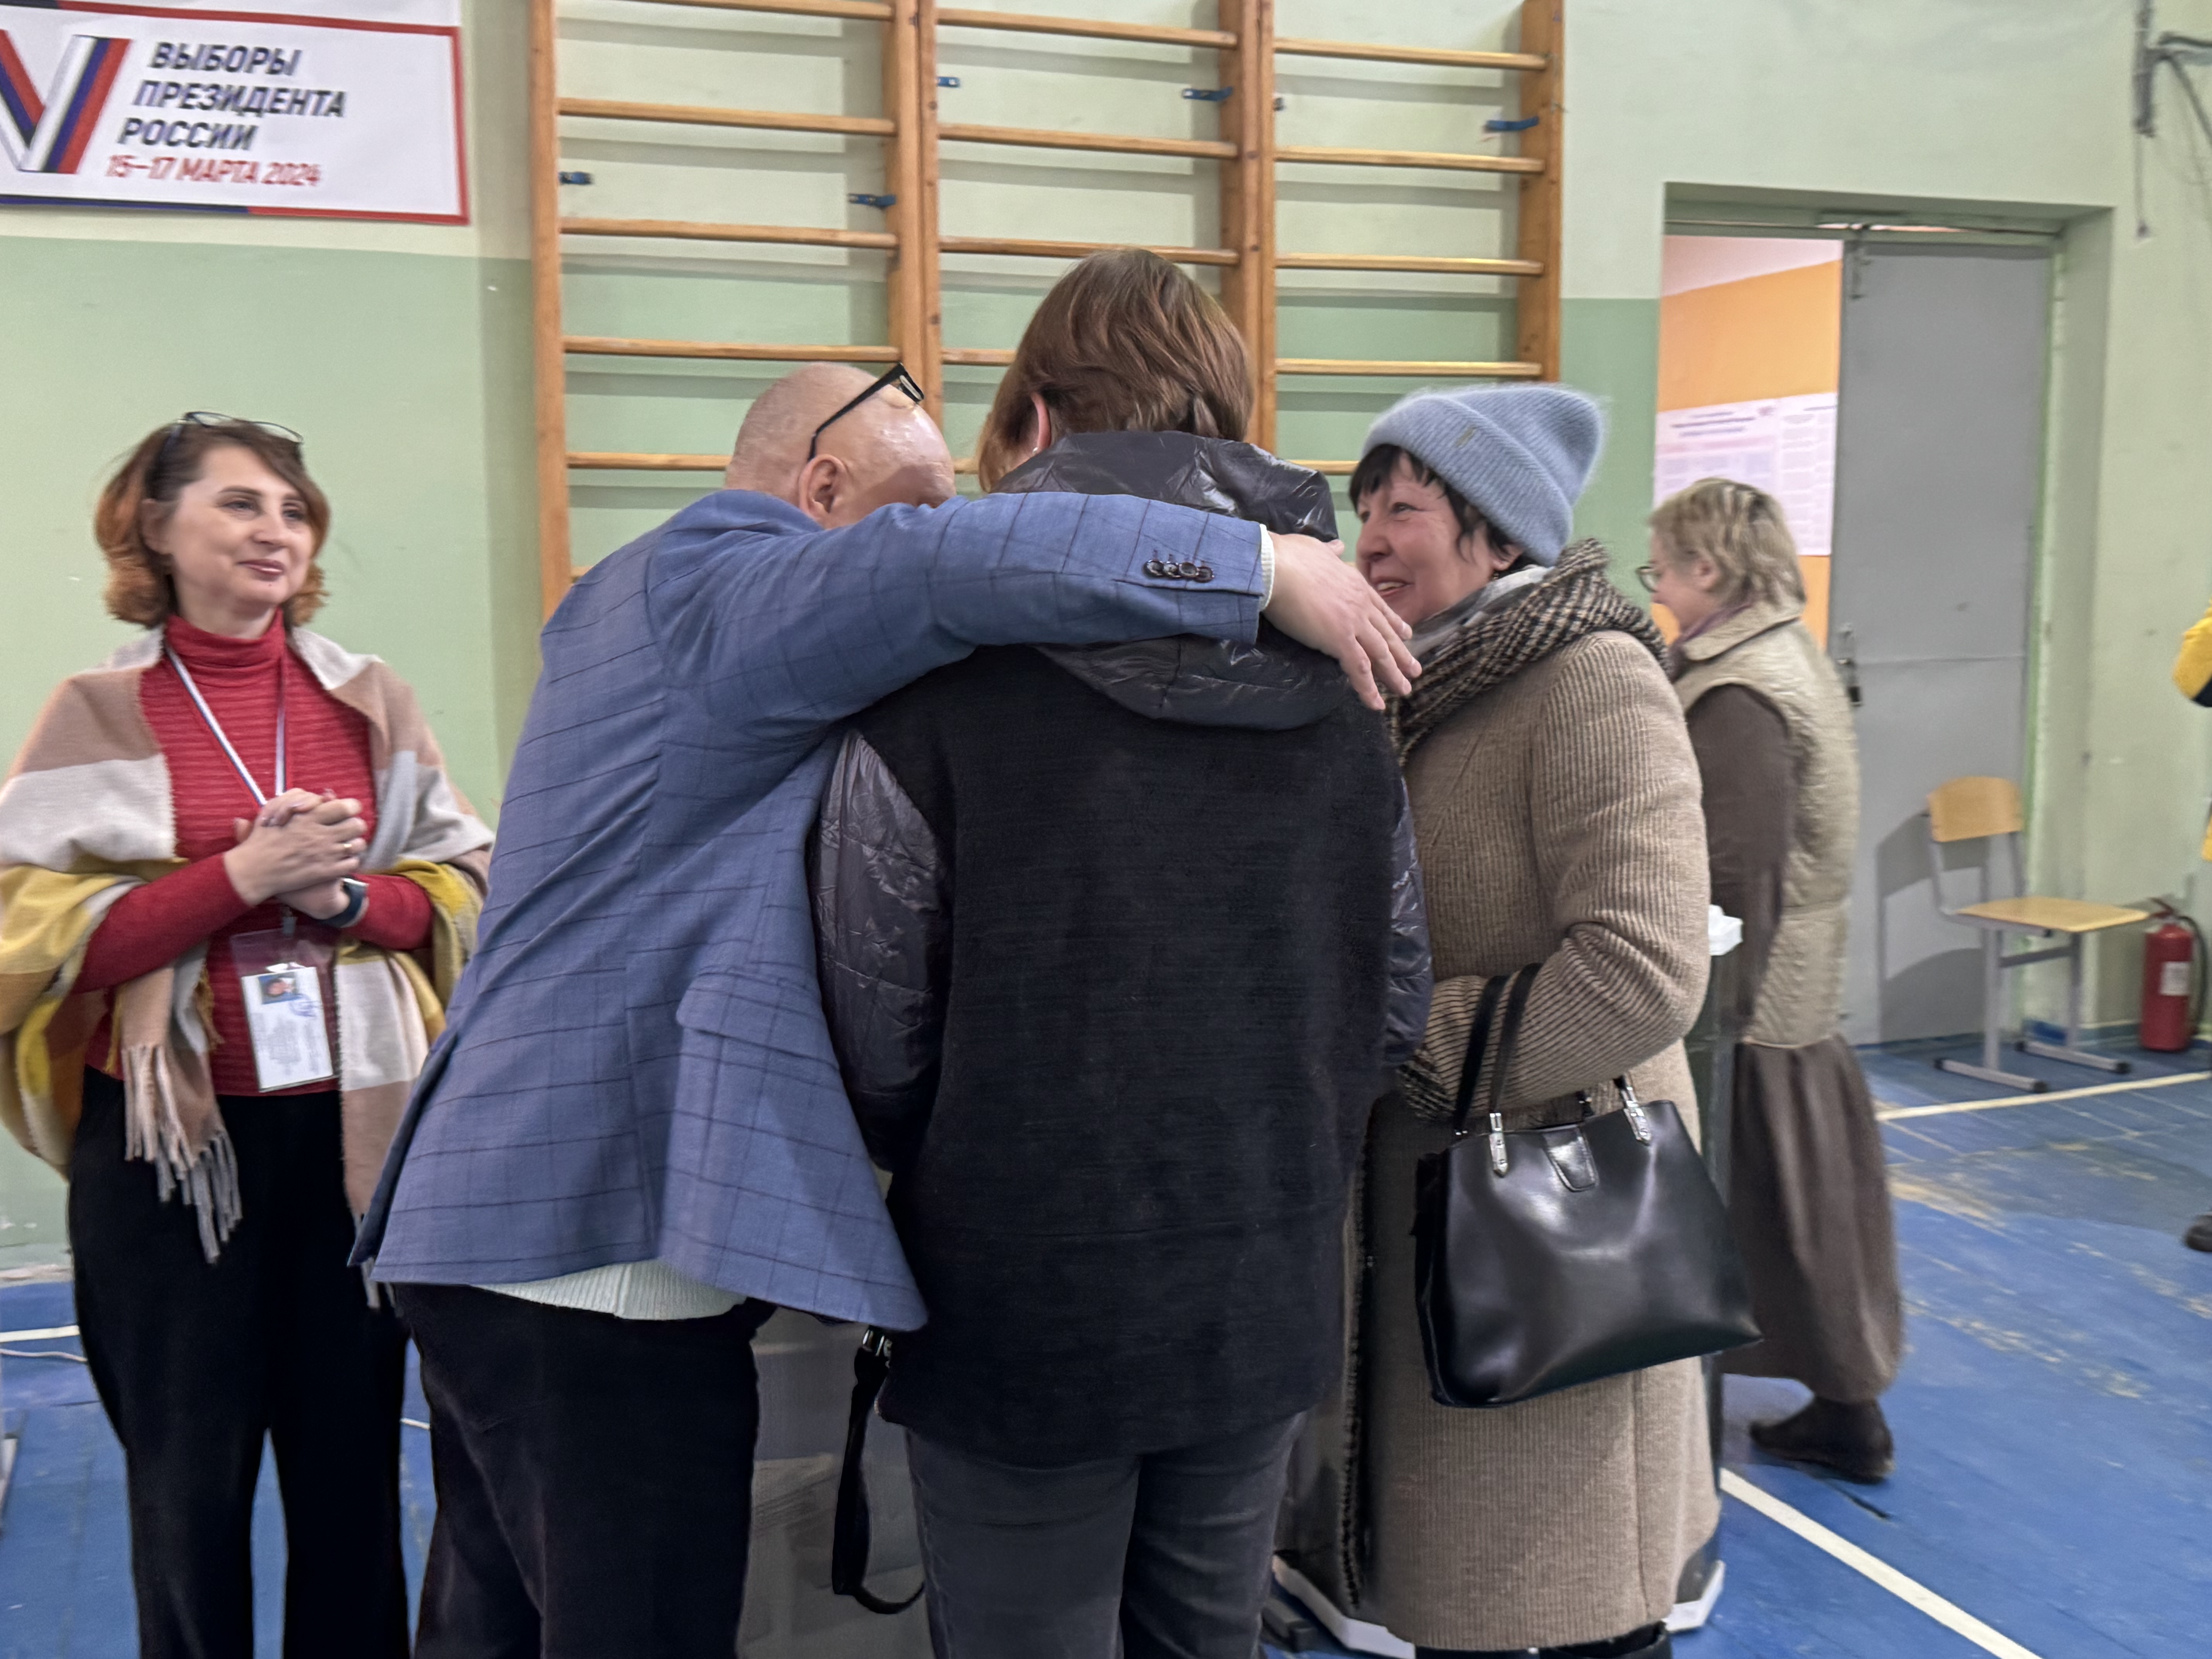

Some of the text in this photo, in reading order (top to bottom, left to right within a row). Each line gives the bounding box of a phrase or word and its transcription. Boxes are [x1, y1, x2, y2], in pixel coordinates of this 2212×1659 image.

[148, 42, 302, 75] ВЫБОРЫ
[132, 79, 345, 117] ПРЕЗИДЕНТА
[117, 117, 259, 150] РОССИИ
[175, 158, 259, 182] МАРТА
[261, 162, 321, 186] 2024
